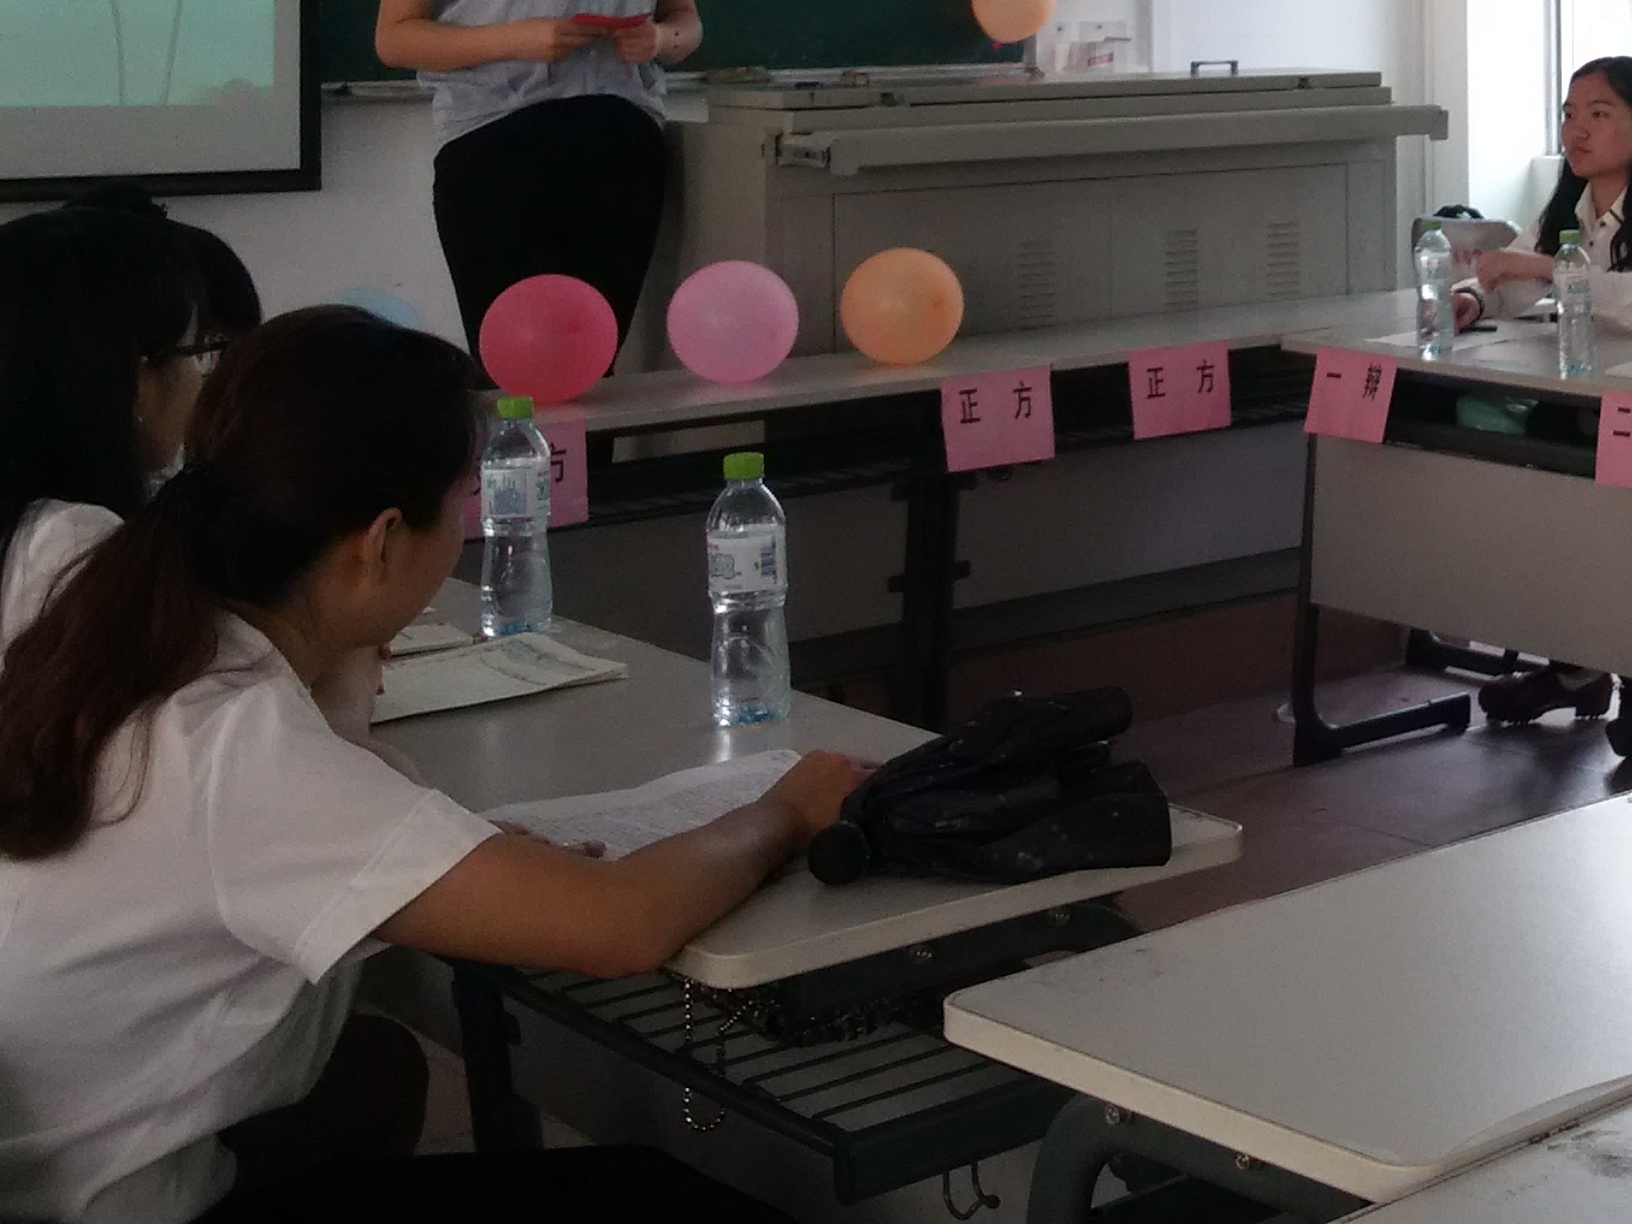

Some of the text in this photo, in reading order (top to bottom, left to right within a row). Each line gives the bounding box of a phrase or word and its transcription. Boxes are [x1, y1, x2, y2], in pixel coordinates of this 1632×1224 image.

[1145, 357, 1216, 400] 正方
[1326, 362, 1380, 401] 一辩
[959, 378, 1033, 426] 正方
